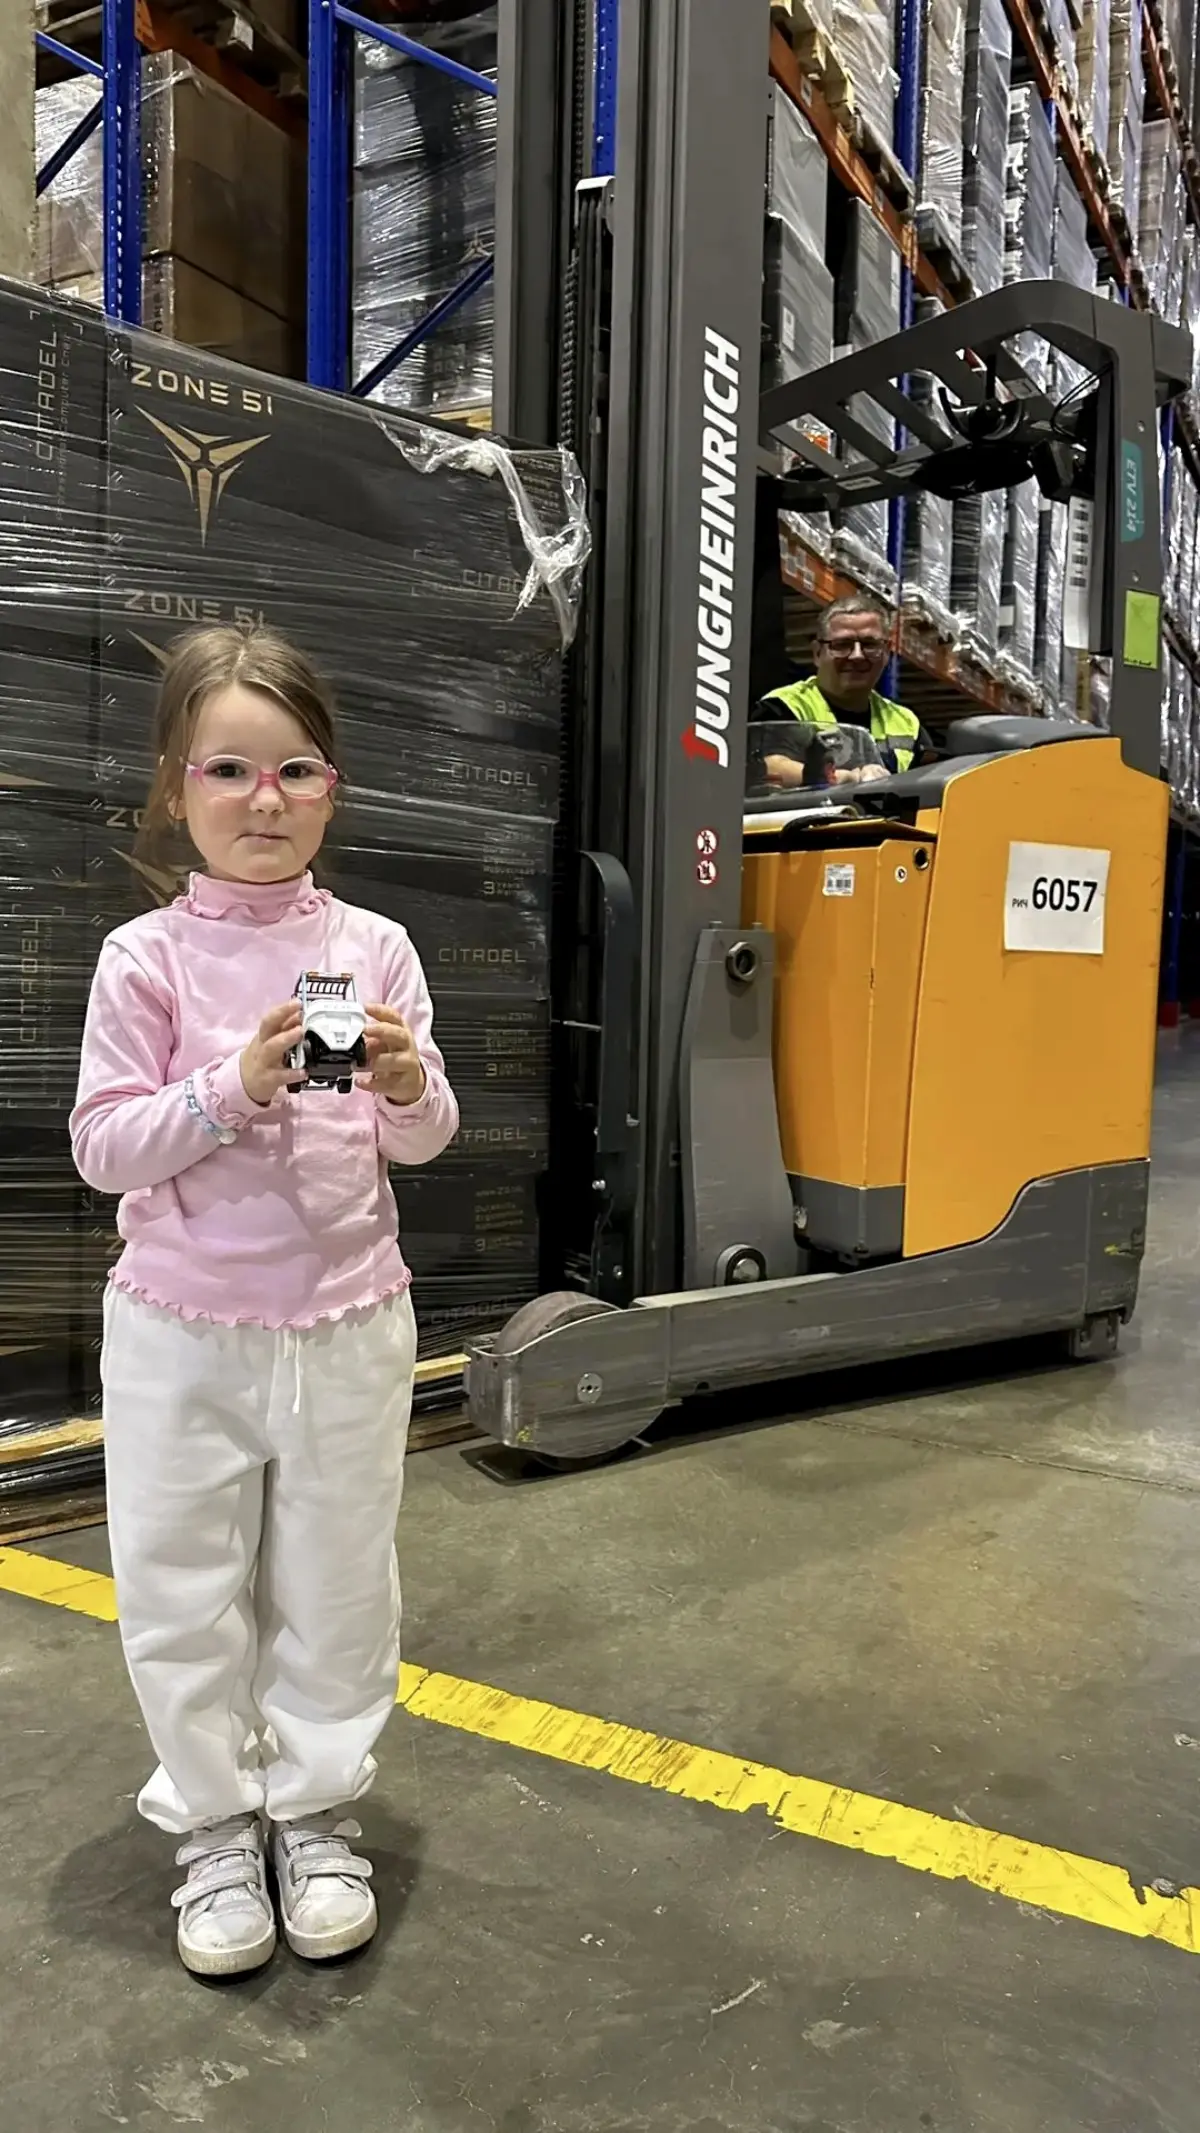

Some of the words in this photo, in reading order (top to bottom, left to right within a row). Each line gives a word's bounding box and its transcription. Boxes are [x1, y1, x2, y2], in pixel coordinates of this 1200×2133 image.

[36, 331, 58, 460] CITADEL
[131, 362, 229, 405] ZONE
[242, 389, 273, 415] 51
[1127, 458, 1137, 496] ETV
[695, 326, 740, 768] JUNGHEINRICH
[124, 588, 221, 622] ZONE
[451, 763, 538, 787] CITADEL
[1032, 876, 1099, 912] 6057
[439, 948, 527, 962] CITADEL
[20, 918, 39, 1042] CITADEL
